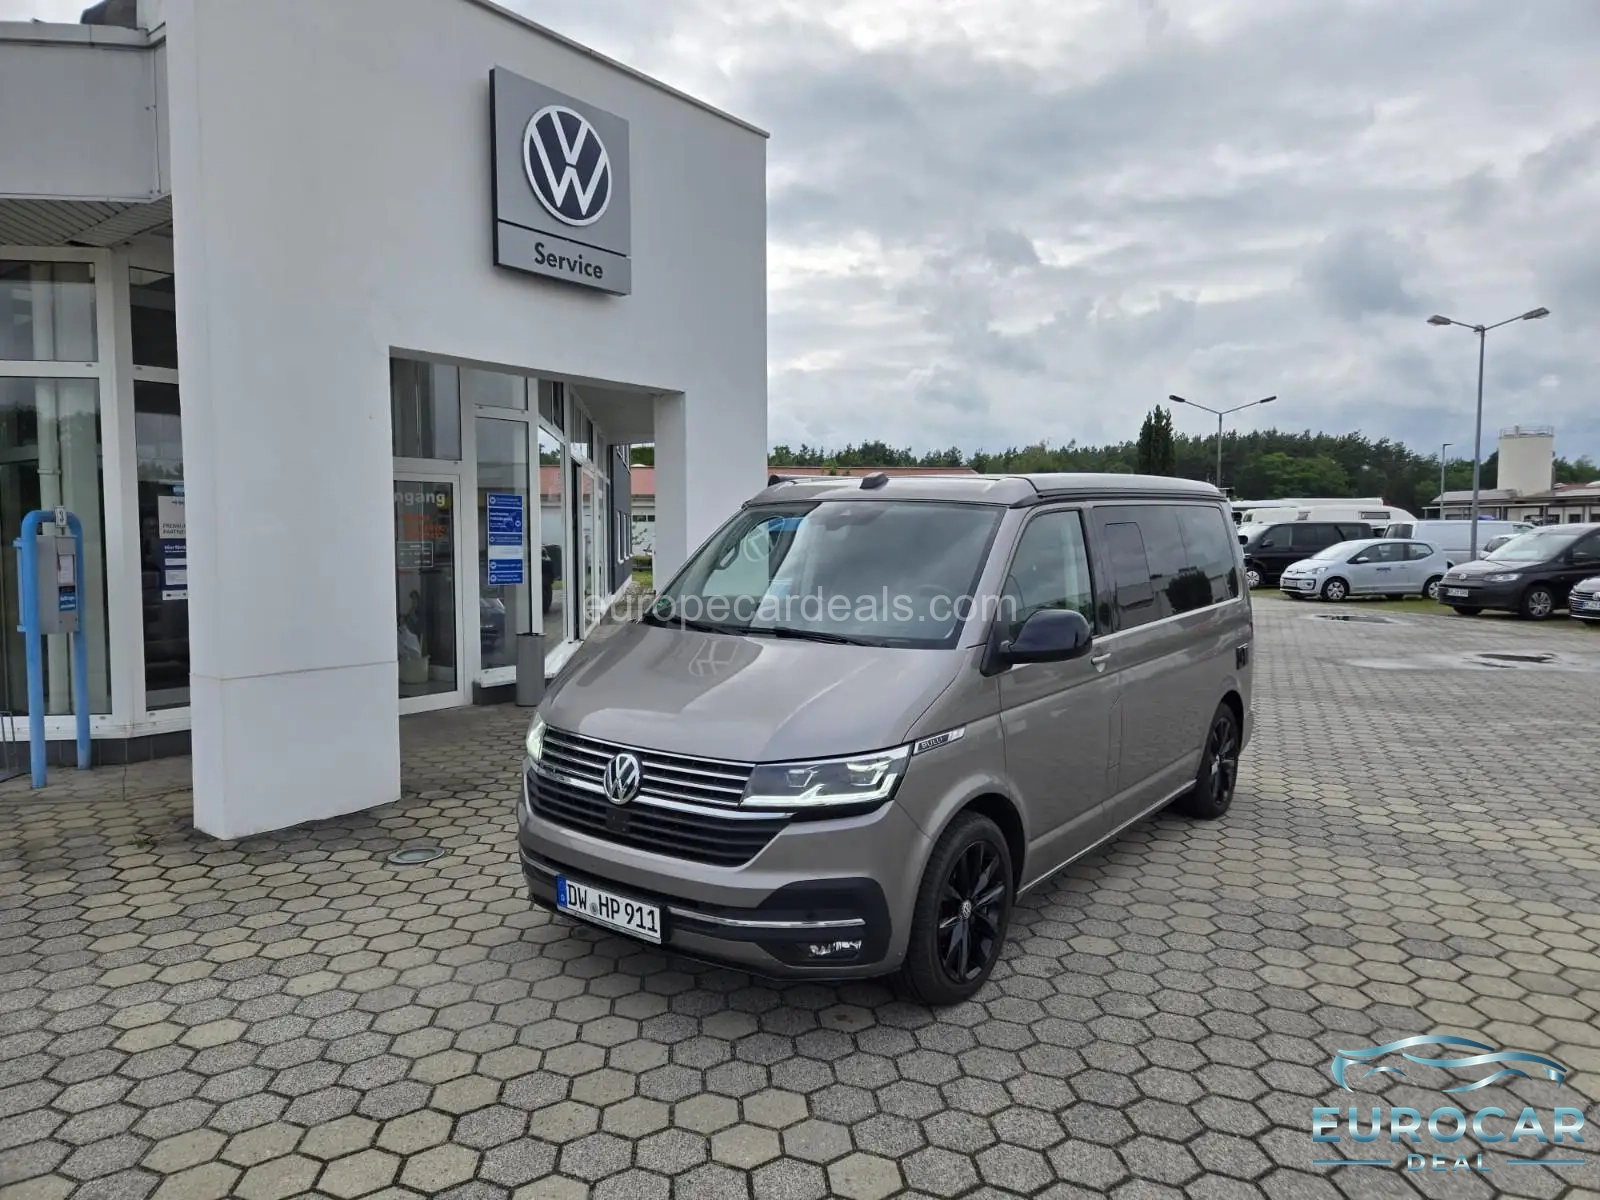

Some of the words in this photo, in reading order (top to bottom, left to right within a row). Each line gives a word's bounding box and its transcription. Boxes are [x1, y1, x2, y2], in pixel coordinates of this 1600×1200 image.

[534, 242, 604, 279] Service
[394, 491, 446, 507] ngang
[567, 883, 587, 910] DW
[598, 893, 621, 920] HP
[624, 902, 658, 933] 911
